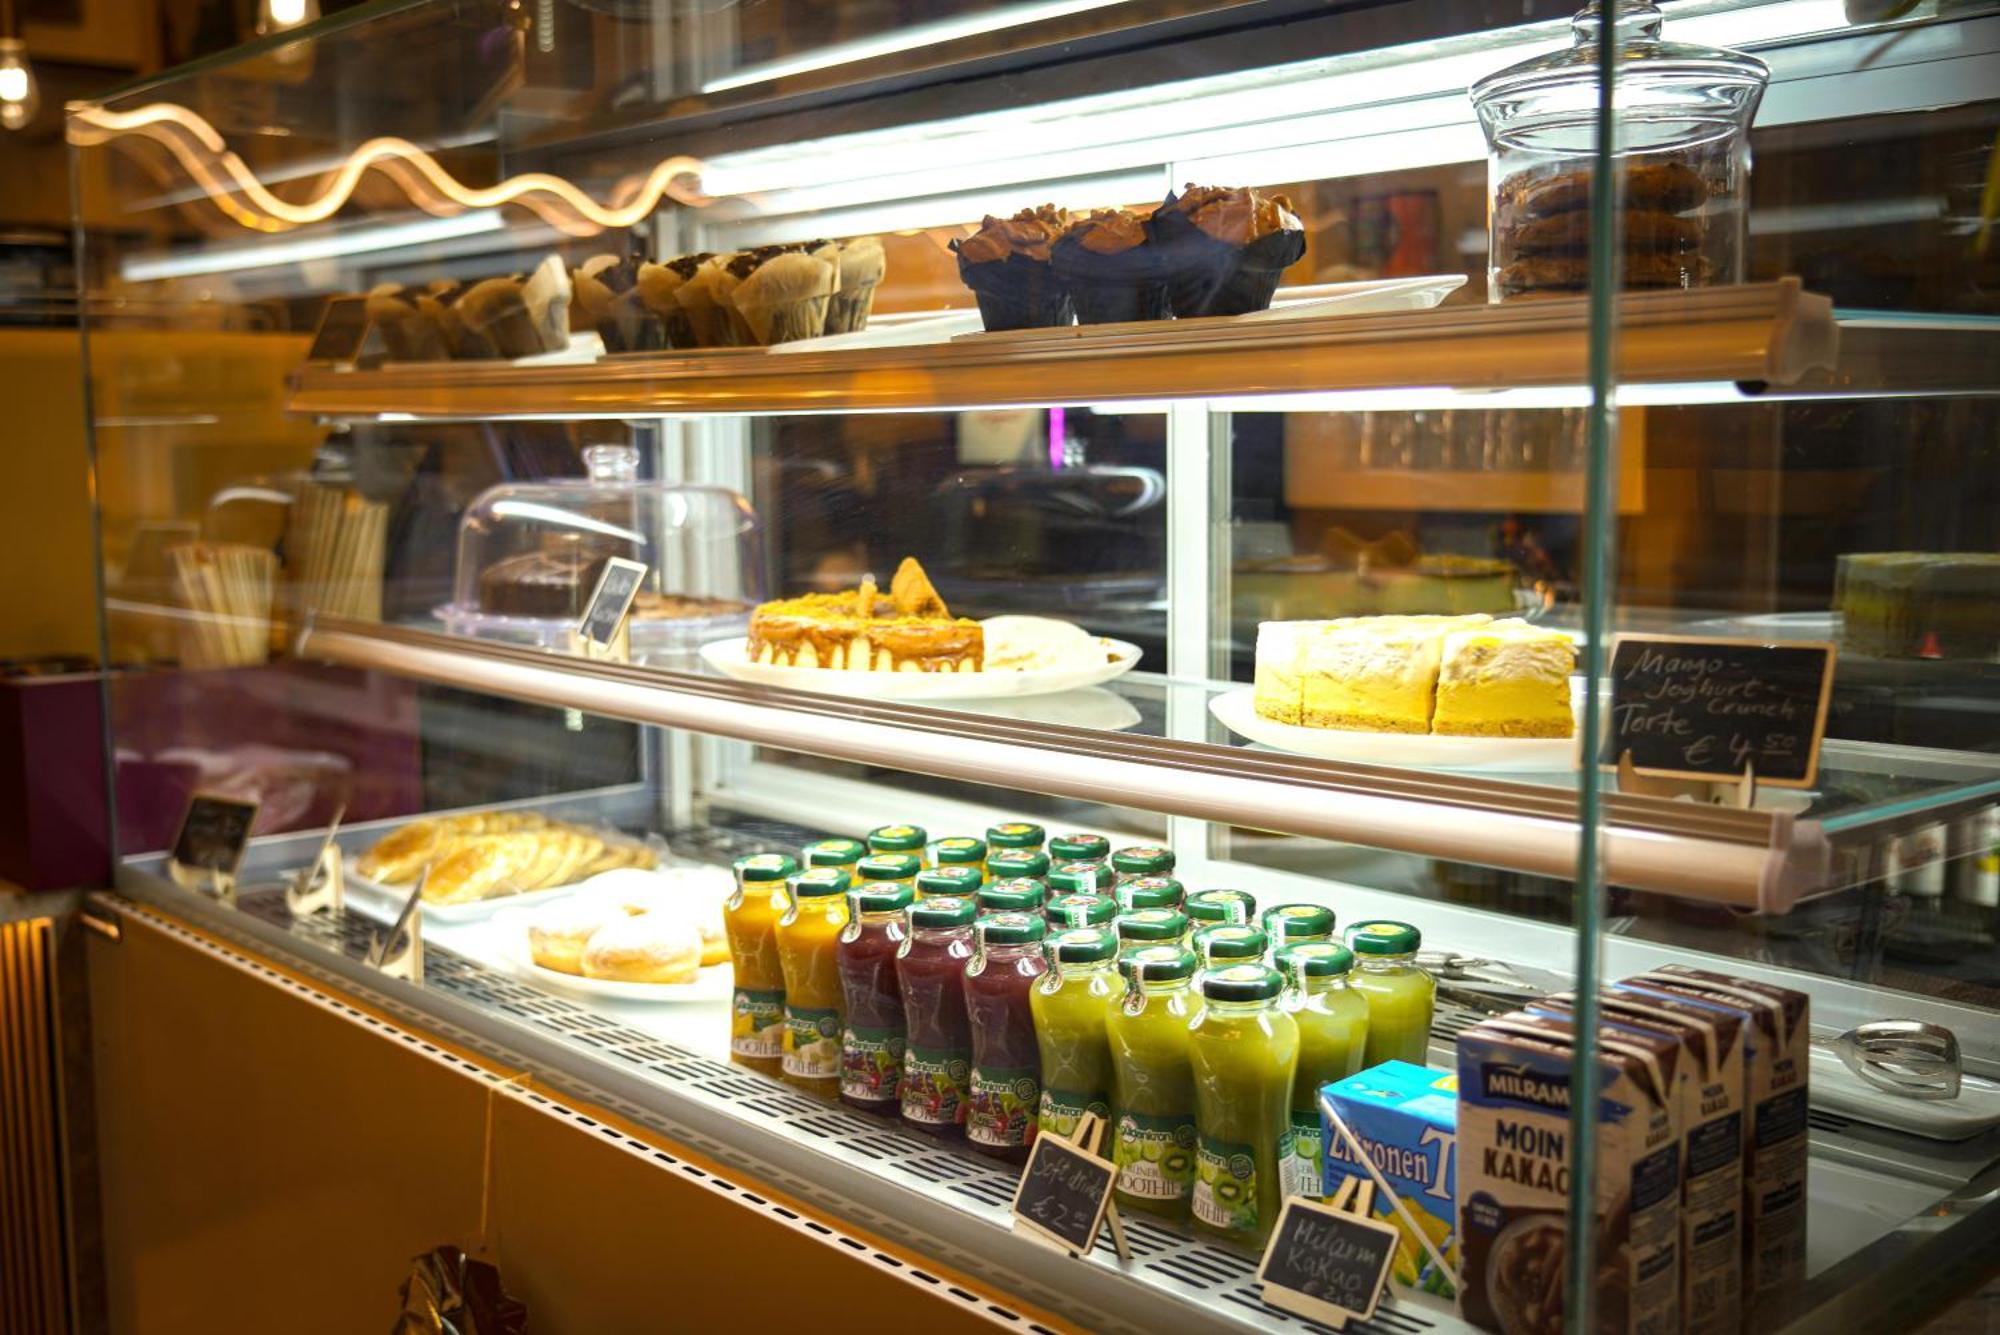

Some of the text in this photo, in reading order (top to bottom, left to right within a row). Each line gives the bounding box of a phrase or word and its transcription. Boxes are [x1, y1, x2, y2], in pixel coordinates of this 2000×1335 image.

[1612, 703, 1694, 736] Torte
[1488, 1074, 1570, 1107] MILRAM
[1496, 1119, 1565, 1161] MOIN
